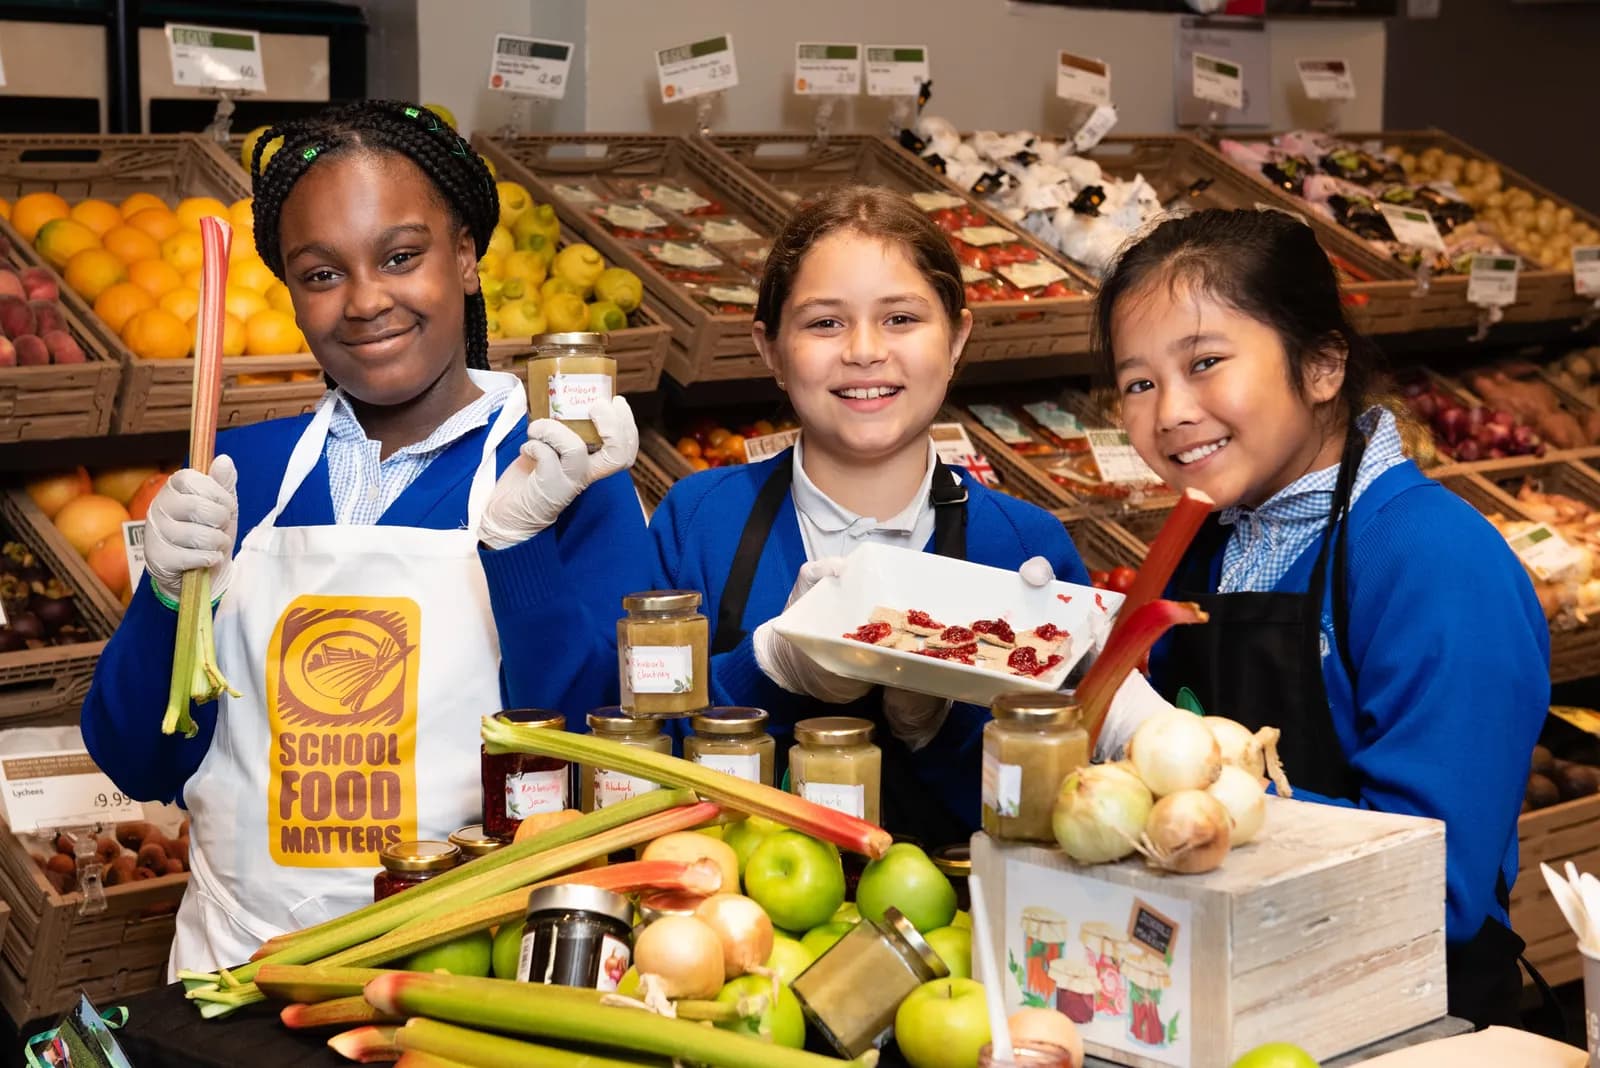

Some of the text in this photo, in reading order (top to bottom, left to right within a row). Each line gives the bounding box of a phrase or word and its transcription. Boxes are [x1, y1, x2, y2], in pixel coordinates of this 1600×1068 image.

[279, 732, 402, 766] SCHOOL
[12, 788, 44, 798] Lychees
[94, 791, 131, 807] £9.99
[279, 771, 401, 821] FOOD
[528, 798, 550, 809] Jam
[281, 825, 402, 854] MATTERS
